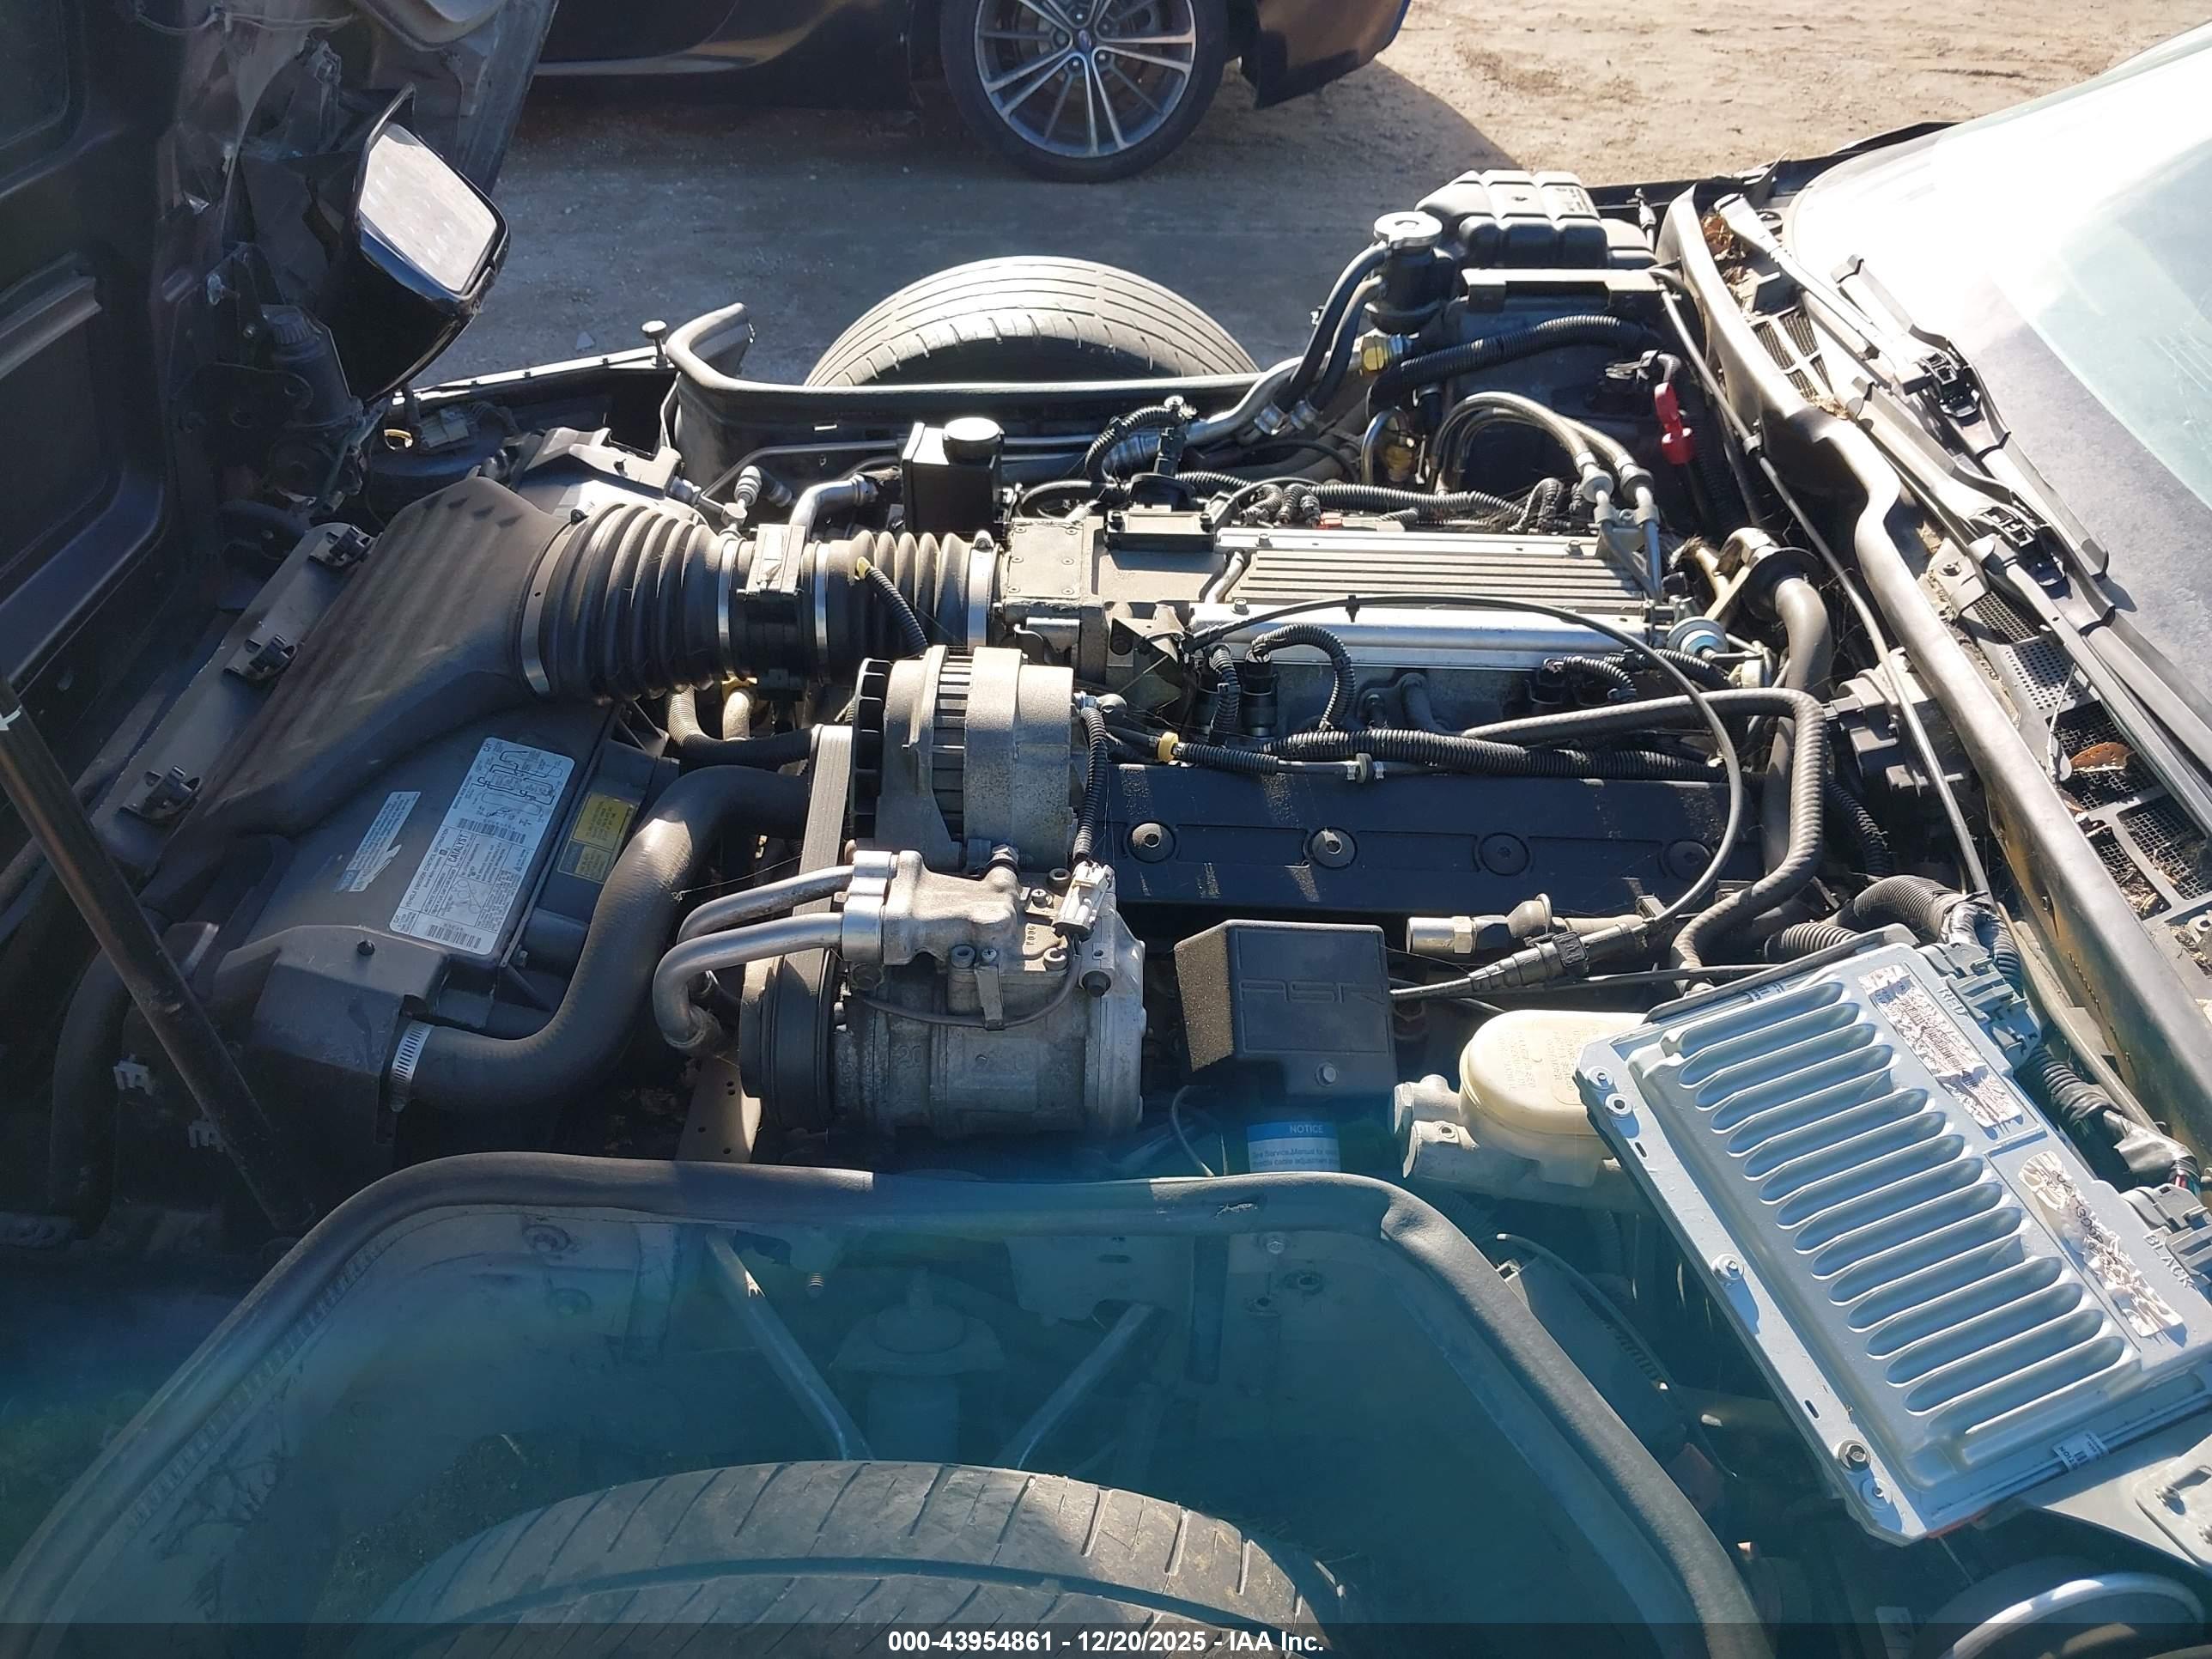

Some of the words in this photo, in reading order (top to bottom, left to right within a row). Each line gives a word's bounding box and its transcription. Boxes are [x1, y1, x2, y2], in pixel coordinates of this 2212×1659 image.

[447, 834, 468, 863] CATALYST
[413, 871, 428, 890] EMISSION
[422, 853, 436, 871] CONTROL
[1237, 978, 1385, 1004] ASR
[1937, 988, 1969, 1016] RED
[1290, 1124, 1323, 1133] NOTICE
[2143, 1235, 2195, 1291] BLACK
